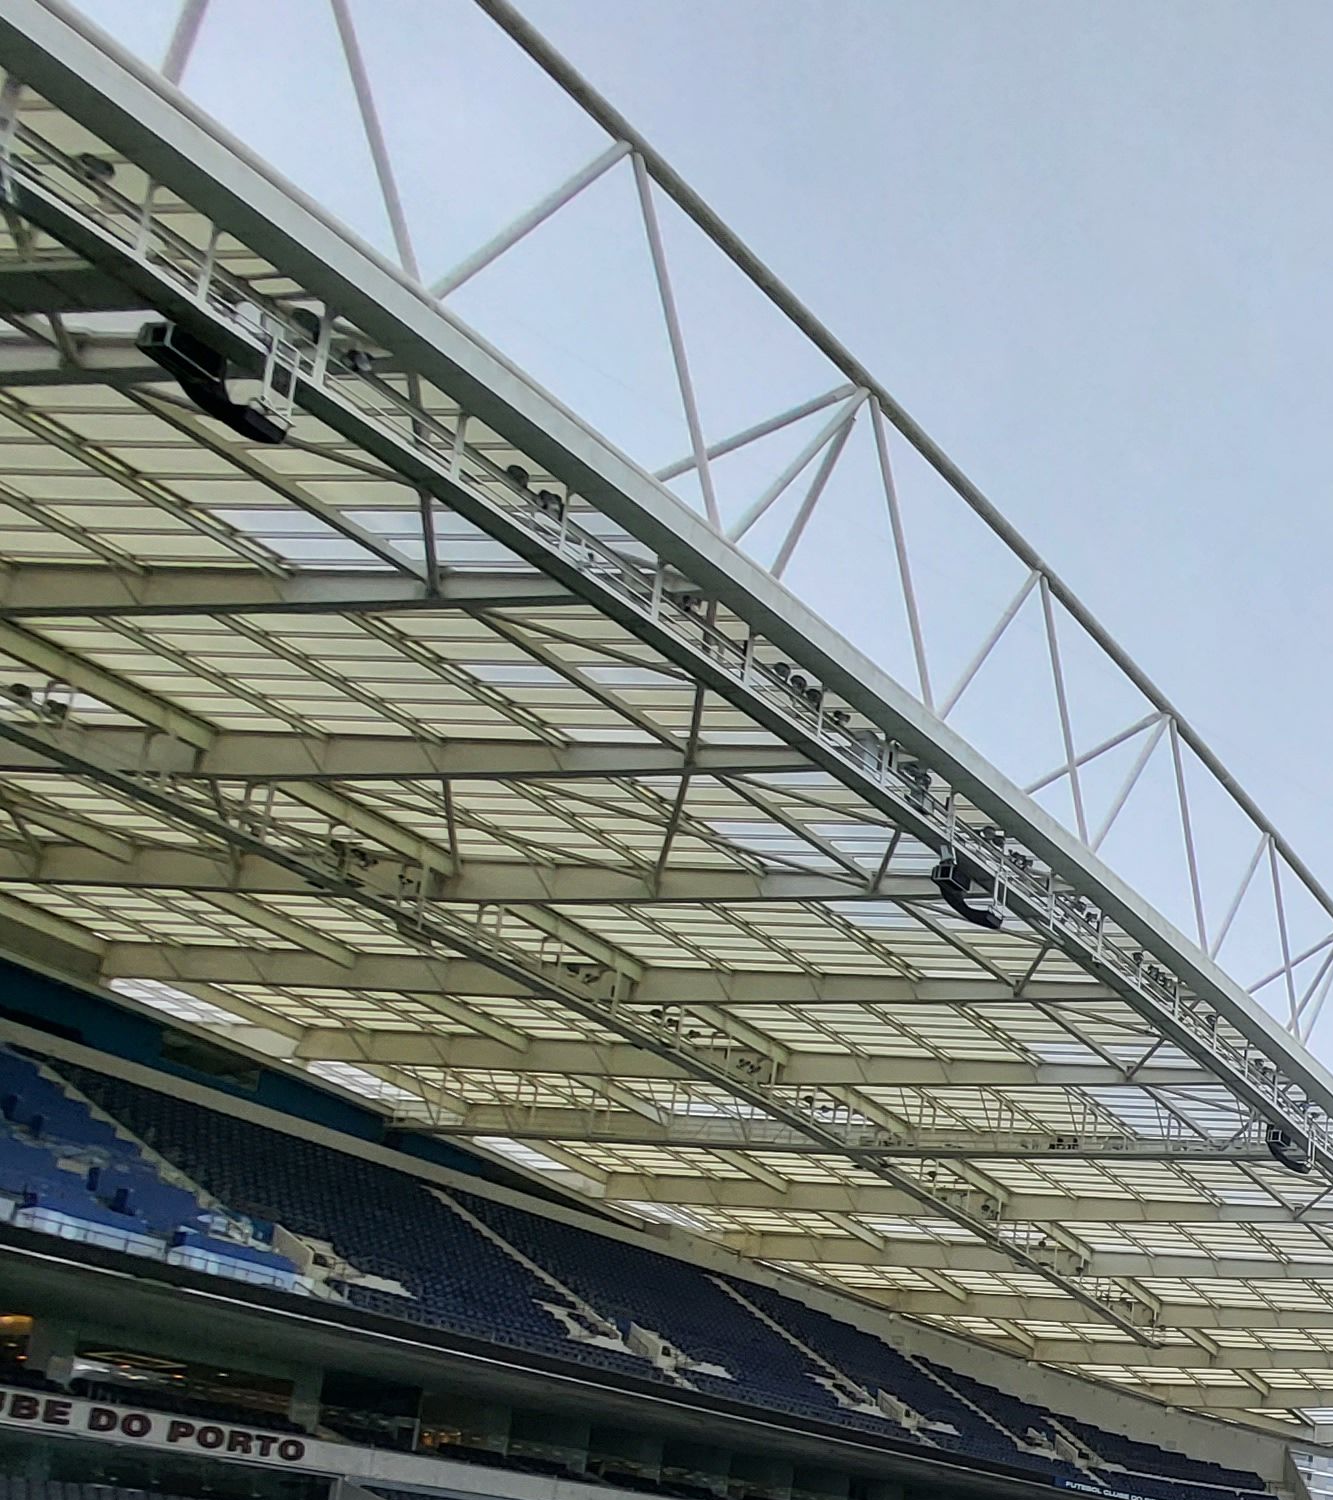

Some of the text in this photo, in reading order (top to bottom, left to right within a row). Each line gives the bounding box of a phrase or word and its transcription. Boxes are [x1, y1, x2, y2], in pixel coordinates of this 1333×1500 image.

[0, 1391, 306, 1461] BE DO PORTO
[1065, 1481, 1102, 1495] FUTEBOL
[1103, 1489, 1129, 1500] CLUBE
